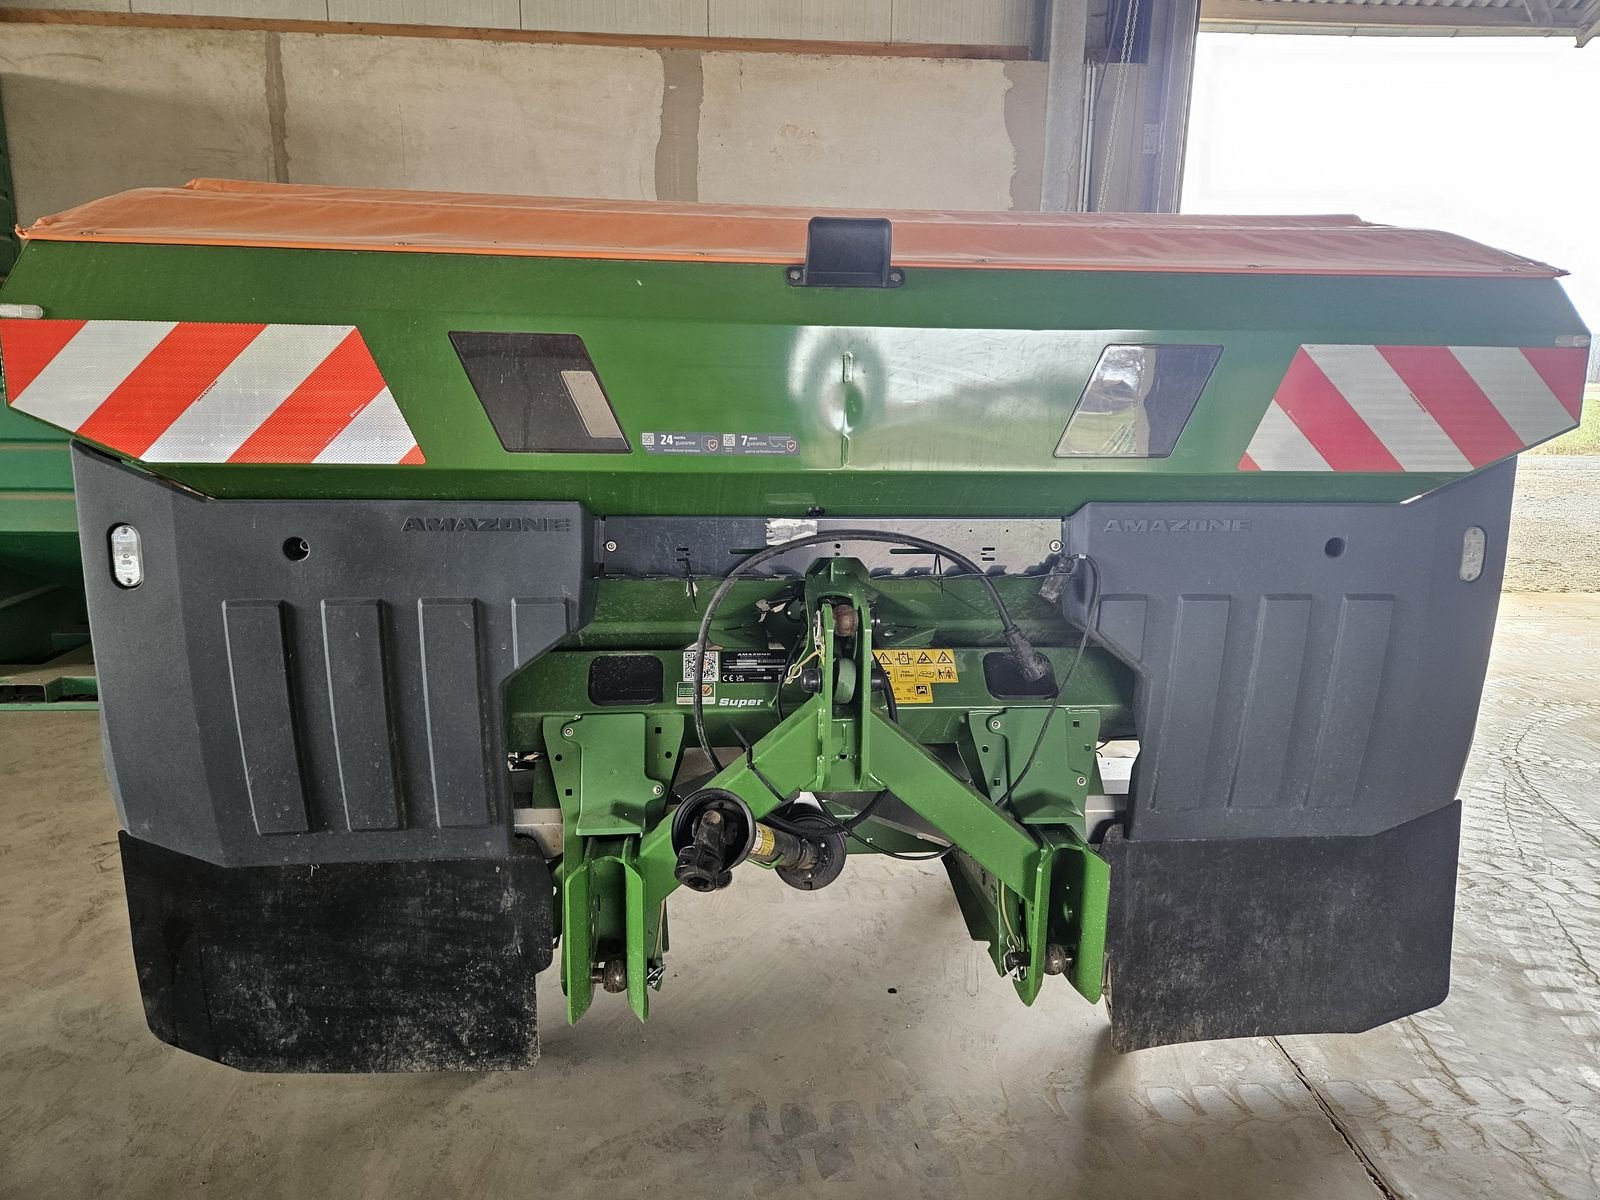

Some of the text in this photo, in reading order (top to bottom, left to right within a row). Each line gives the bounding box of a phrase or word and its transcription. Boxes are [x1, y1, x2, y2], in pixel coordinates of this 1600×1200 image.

[660, 434, 673, 445] 24
[741, 435, 748, 446] 7
[401, 517, 570, 532] AMAZONE
[1103, 519, 1252, 533] AMAZONE
[719, 698, 764, 707] Super
